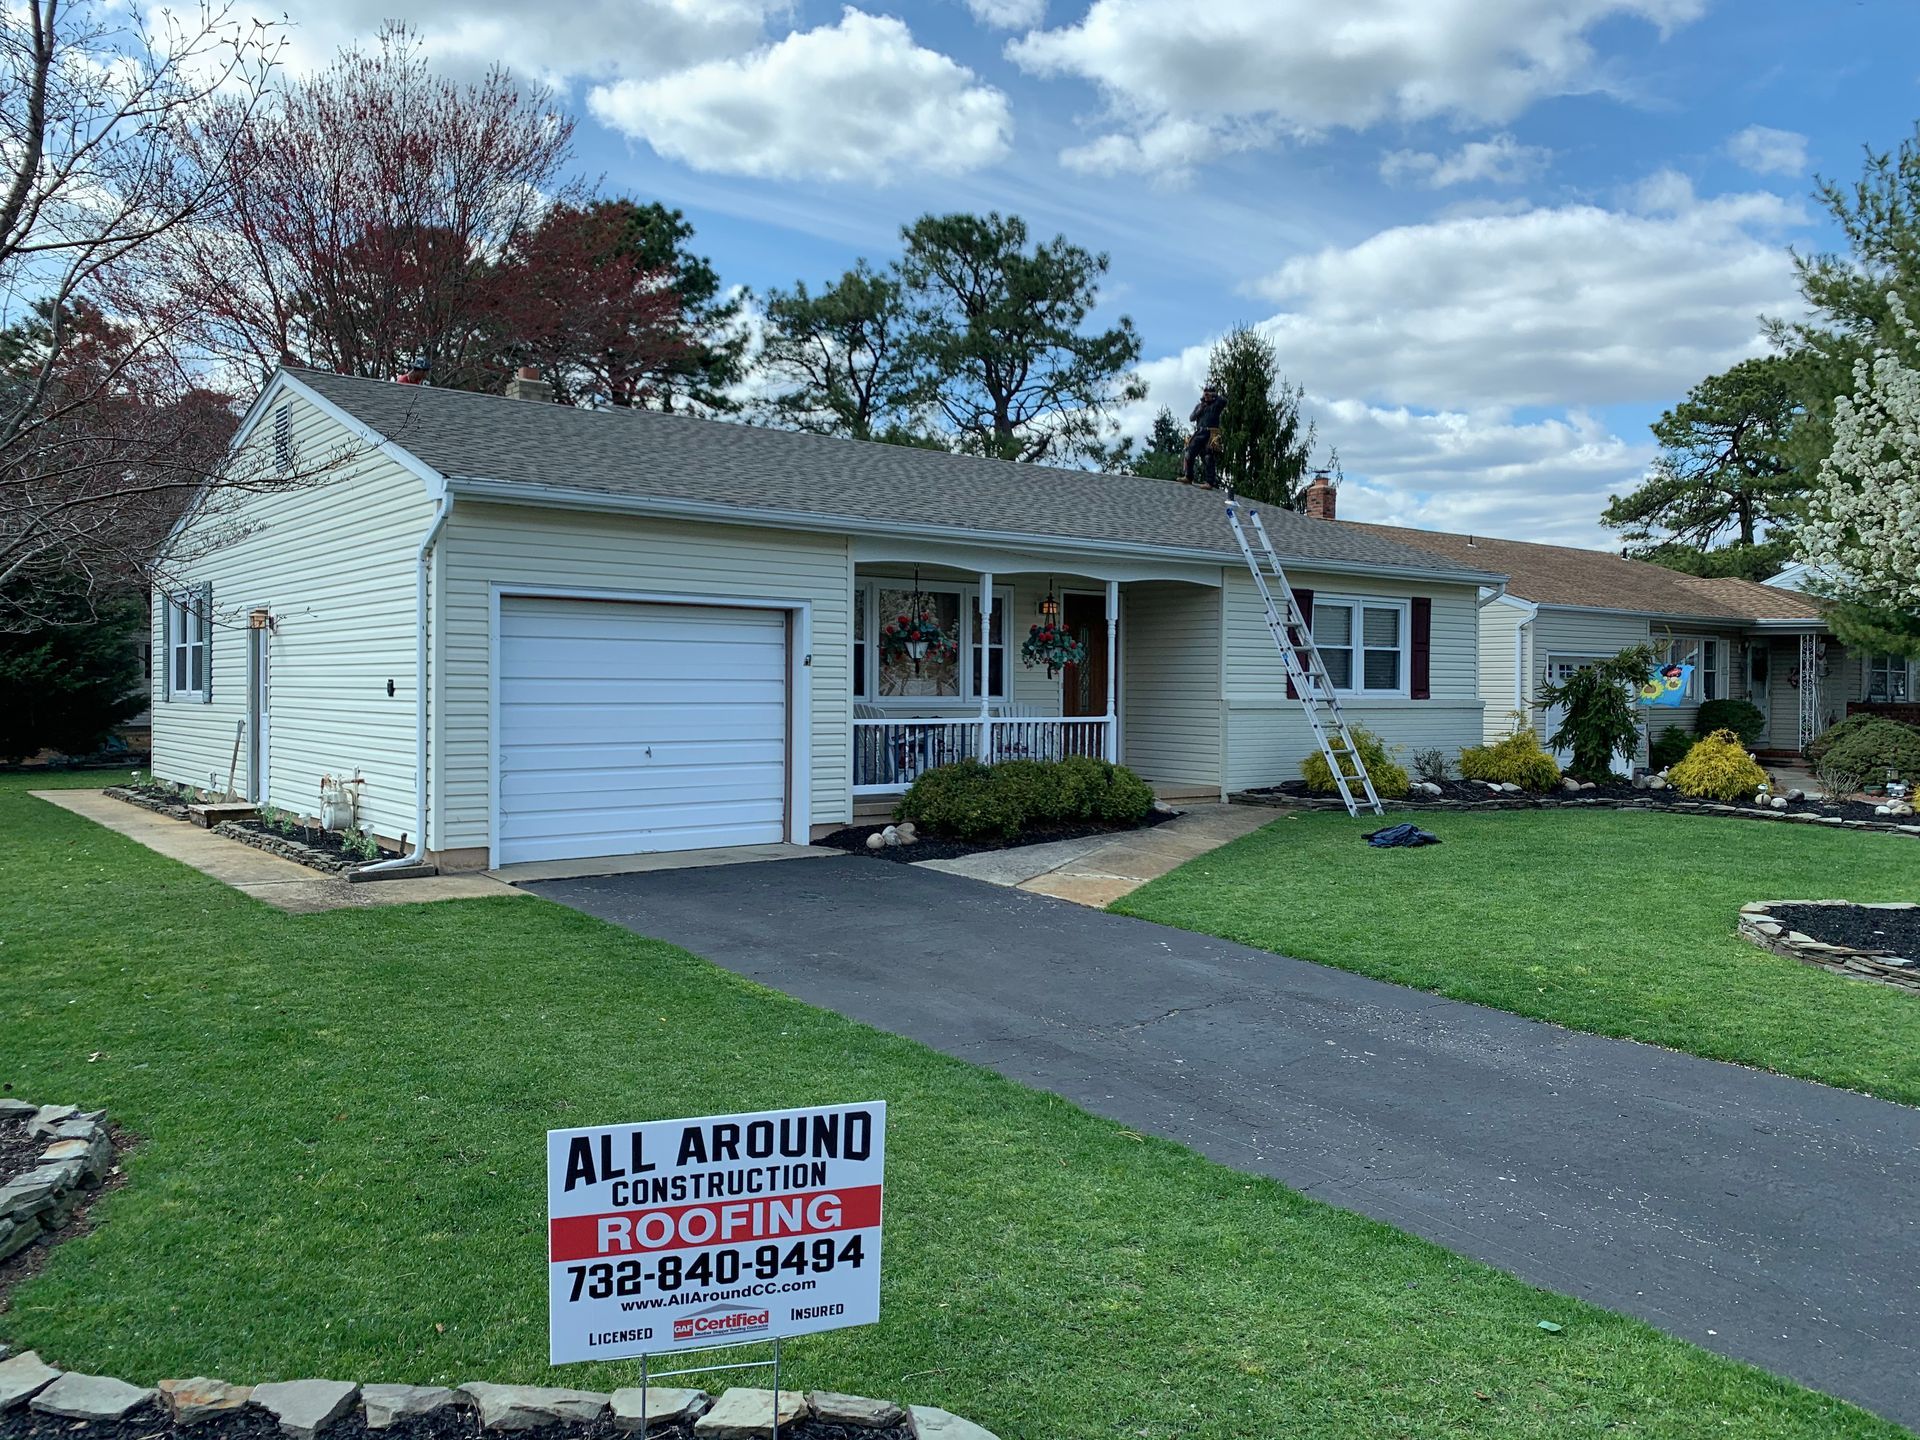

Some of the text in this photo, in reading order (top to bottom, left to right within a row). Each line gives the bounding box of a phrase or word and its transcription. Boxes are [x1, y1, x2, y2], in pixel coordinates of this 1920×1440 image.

[564, 1111, 872, 1192] ALL AROUND
[612, 1161, 826, 1207] CONSTRUCTION
[598, 1194, 842, 1253] ROOFING
[567, 1235, 864, 1302] 732-840-9494
[621, 1278, 816, 1312] www.AllAroundCC.com
[790, 1303, 844, 1321] INSURED
[589, 1327, 653, 1346] LICENSED
[674, 1310, 769, 1333] GAF Certified
